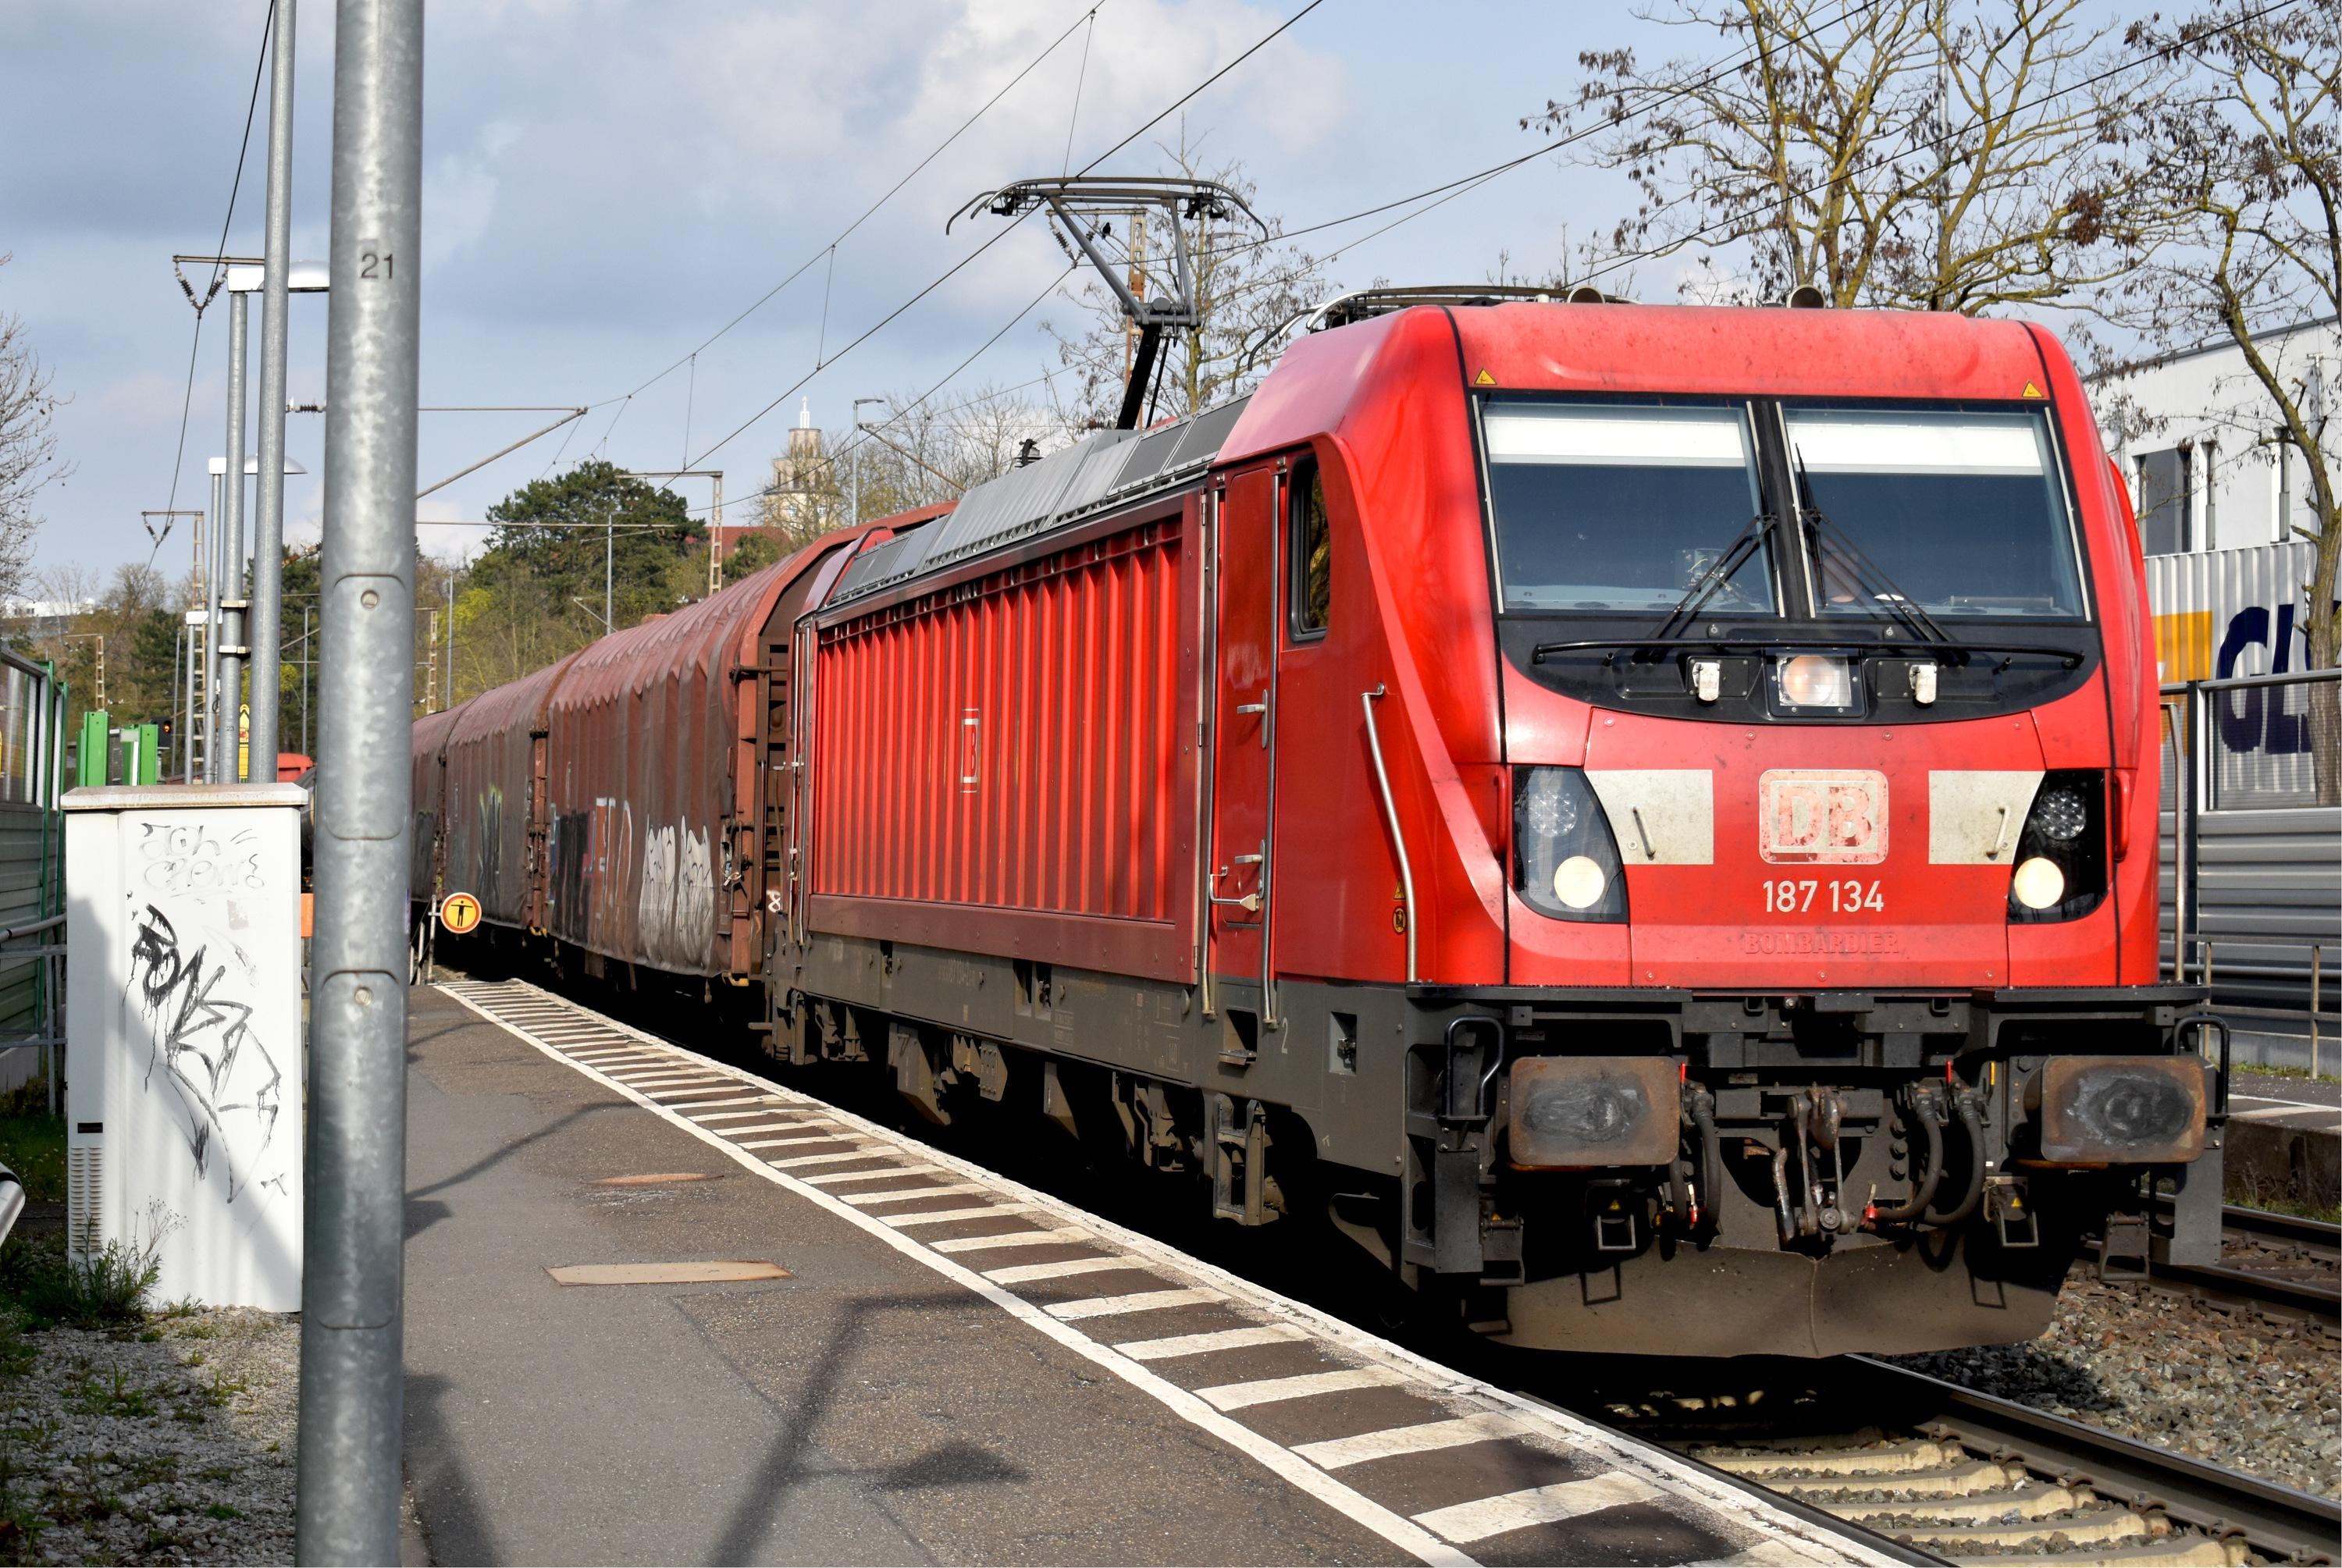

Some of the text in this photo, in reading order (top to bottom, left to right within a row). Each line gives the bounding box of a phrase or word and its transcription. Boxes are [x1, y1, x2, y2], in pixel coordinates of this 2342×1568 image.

[361, 253, 393, 279] 21
[1776, 784, 1874, 849] DB
[1763, 880, 1885, 912] 187 134
[1743, 931, 1900, 955] BOMBARDIER
[1281, 1017, 1289, 1054] 2
